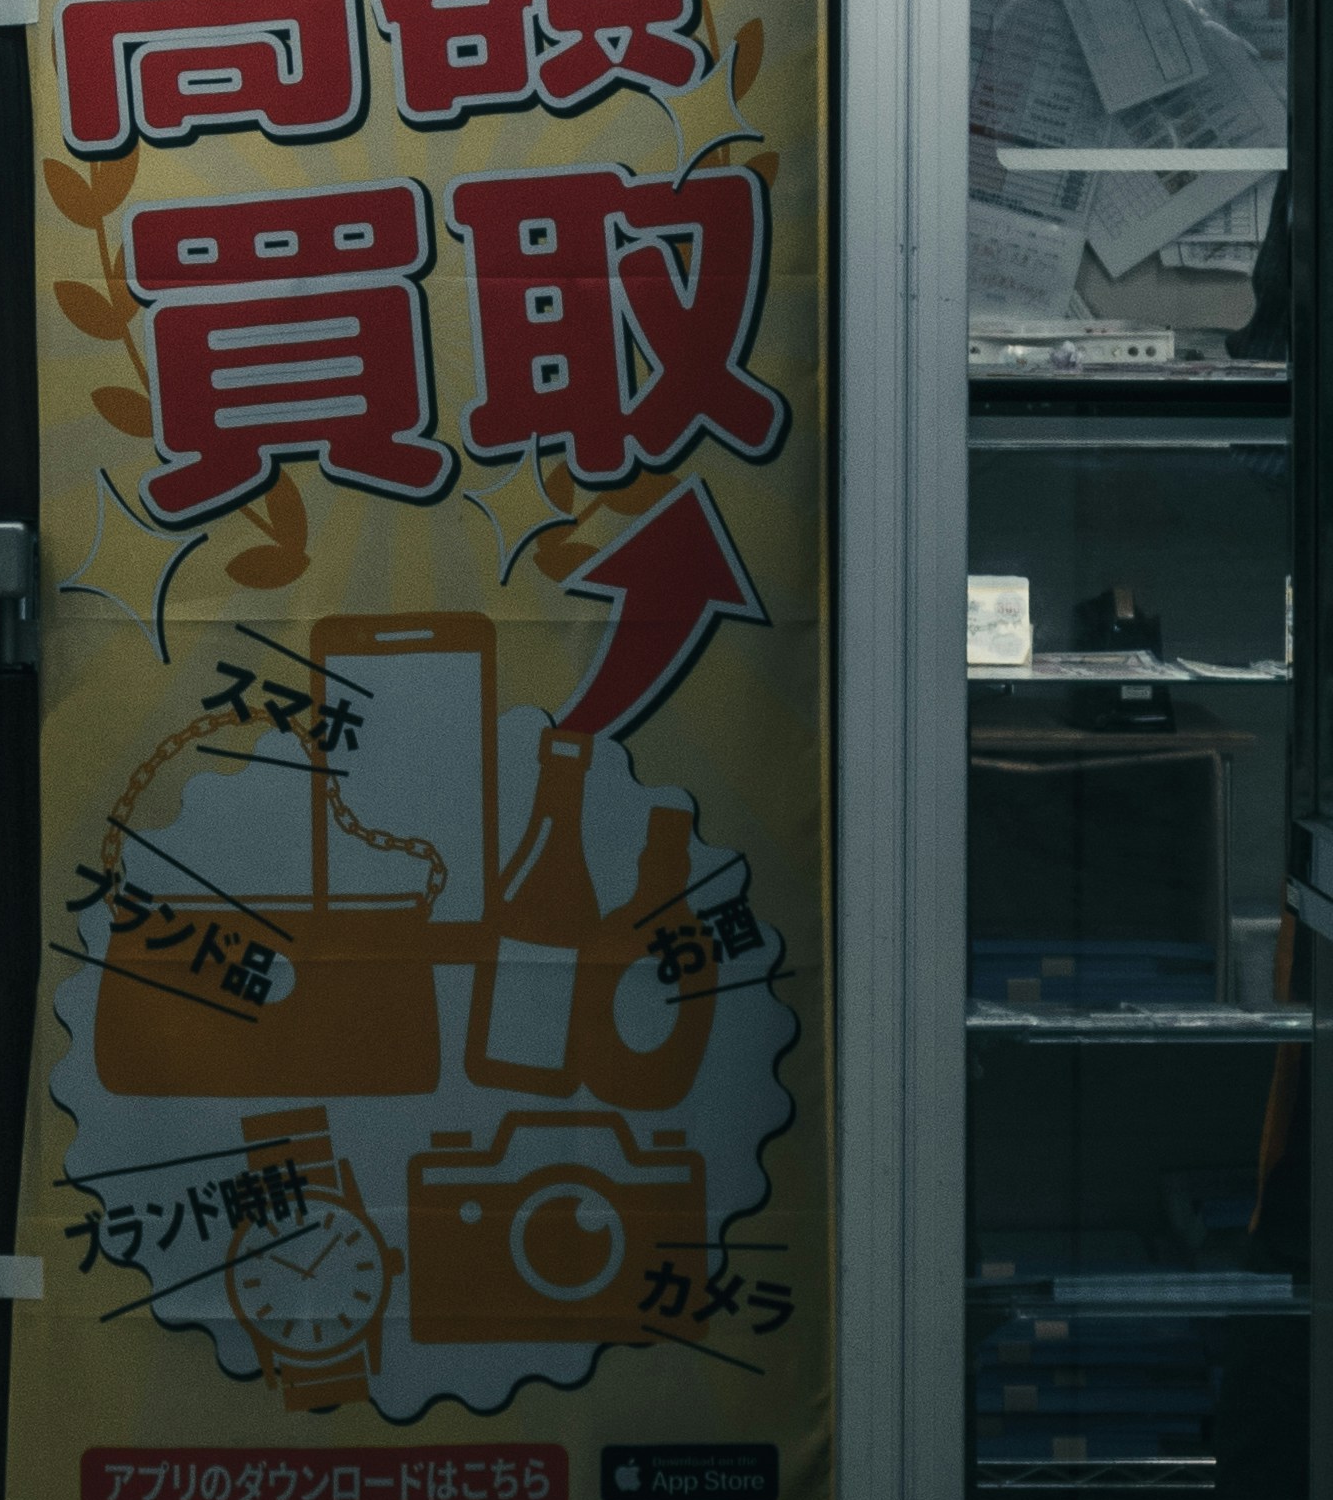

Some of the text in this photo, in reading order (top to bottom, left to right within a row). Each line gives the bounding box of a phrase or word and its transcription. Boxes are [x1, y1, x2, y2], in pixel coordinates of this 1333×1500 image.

[128, 166, 790, 527] 買取
[198, 661, 365, 759] スマホ
[63, 862, 281, 1008] ブランド品
[642, 886, 765, 989] お酒
[60, 1156, 312, 1280] ブランド時計
[638, 1256, 795, 1337] カメラ
[651, 1470, 764, 1494] App Store
